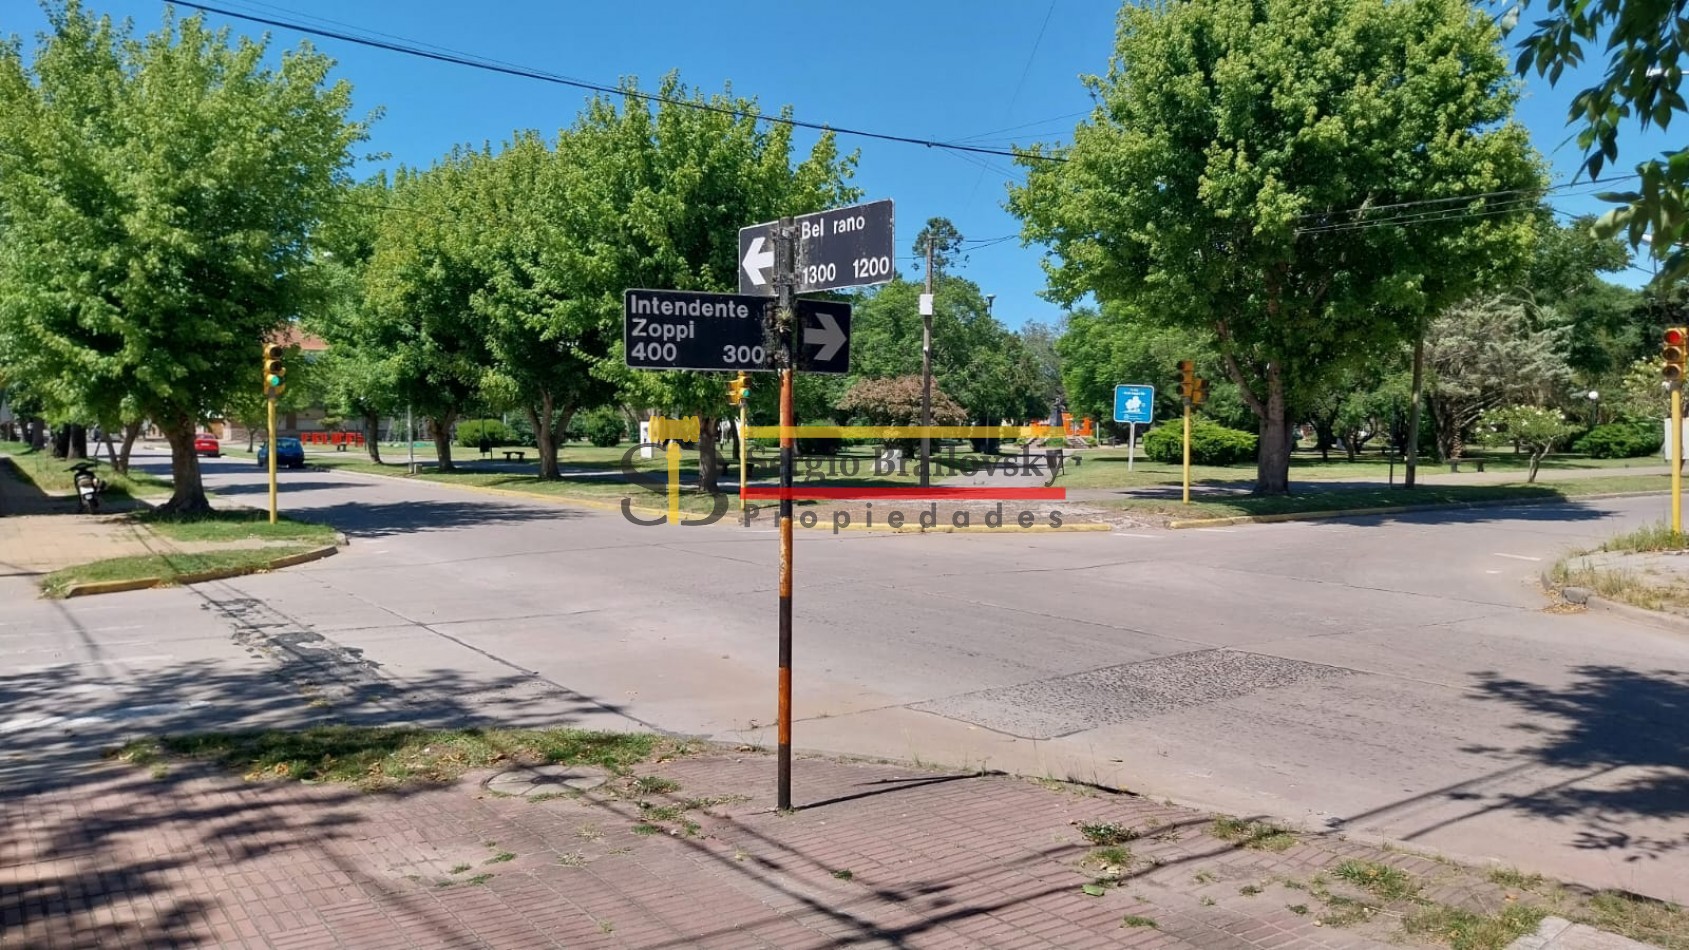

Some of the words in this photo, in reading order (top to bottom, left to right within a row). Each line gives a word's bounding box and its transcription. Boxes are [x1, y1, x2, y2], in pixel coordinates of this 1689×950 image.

[801, 216, 866, 240] Belrano
[802, 262, 836, 285] 1300
[852, 255, 890, 279] 1200
[630, 294, 750, 319] Intendente
[630, 317, 696, 342] Zoppi
[630, 341, 678, 362] 400
[722, 344, 766, 364] 300
